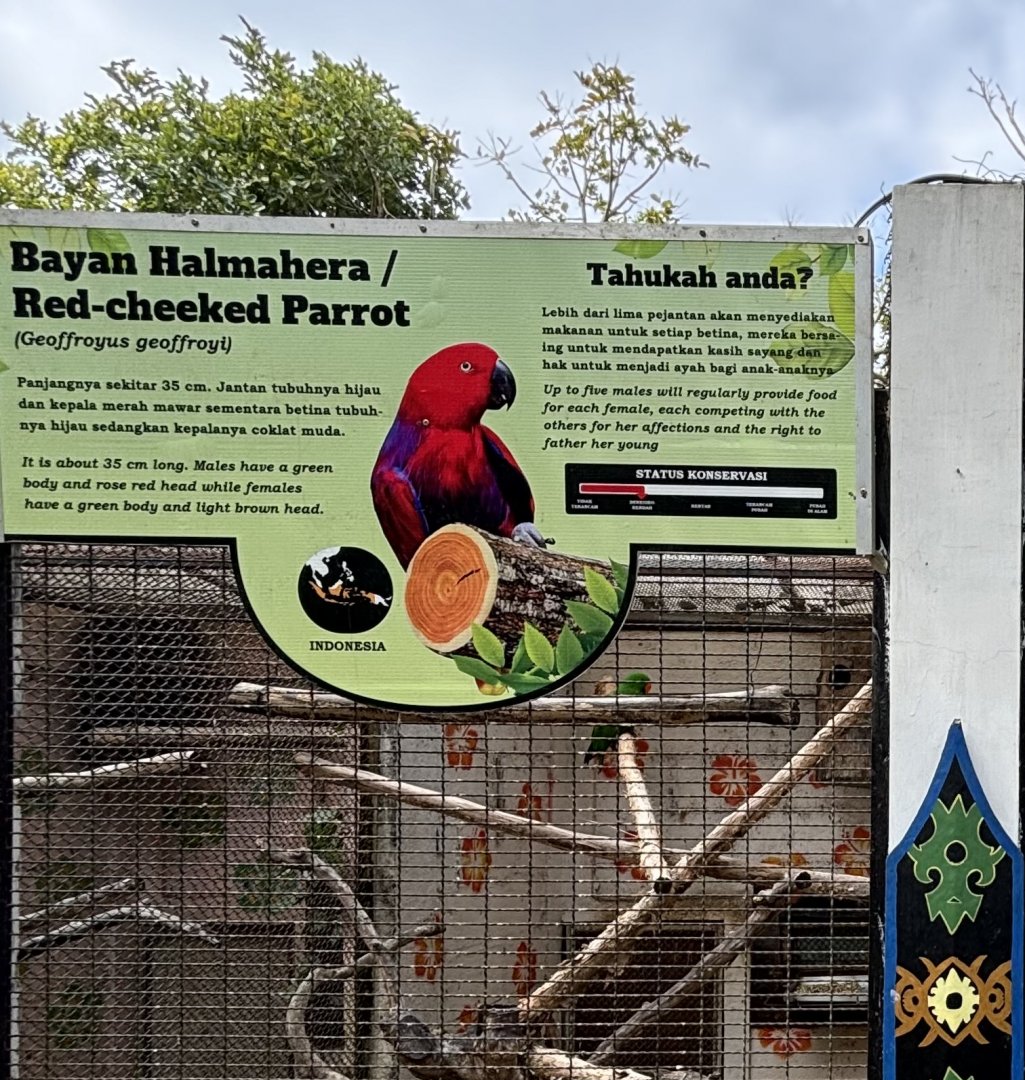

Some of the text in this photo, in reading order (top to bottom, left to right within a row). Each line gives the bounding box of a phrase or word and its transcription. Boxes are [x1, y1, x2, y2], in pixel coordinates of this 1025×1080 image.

[9, 240, 398, 287] Bayan Halmahera /
[586, 263, 813, 289] Tahukah anda?
[12, 286, 410, 327] Red-cheeked Parrot
[541, 306, 836, 325] Lebih dari lima pejantan akan menyediakan
[14, 330, 231, 354] (Geoffroyus geoffroyi)
[542, 341, 822, 361] ing untuk mendapatkan kasih sayang dan
[16, 376, 381, 398] Panjangnya sekitar 35 cm. Jantan tubuhnya hijau
[543, 384, 837, 402] Up to five males will regularly provide food
[18, 397, 382, 416] dan kepala merah mawar sementara betina tubuh-
[19, 419, 345, 438] nya hijau sedangkan kepalanya coklat muda.
[543, 419, 821, 437] others for her affections and the right to
[21, 456, 333, 475] It is about 35 cm long. Males have a green
[635, 469, 767, 481] STATUS KONSERVASI
[24, 498, 323, 516] have a green body and light brown head.
[309, 640, 386, 651] INDONESIA
